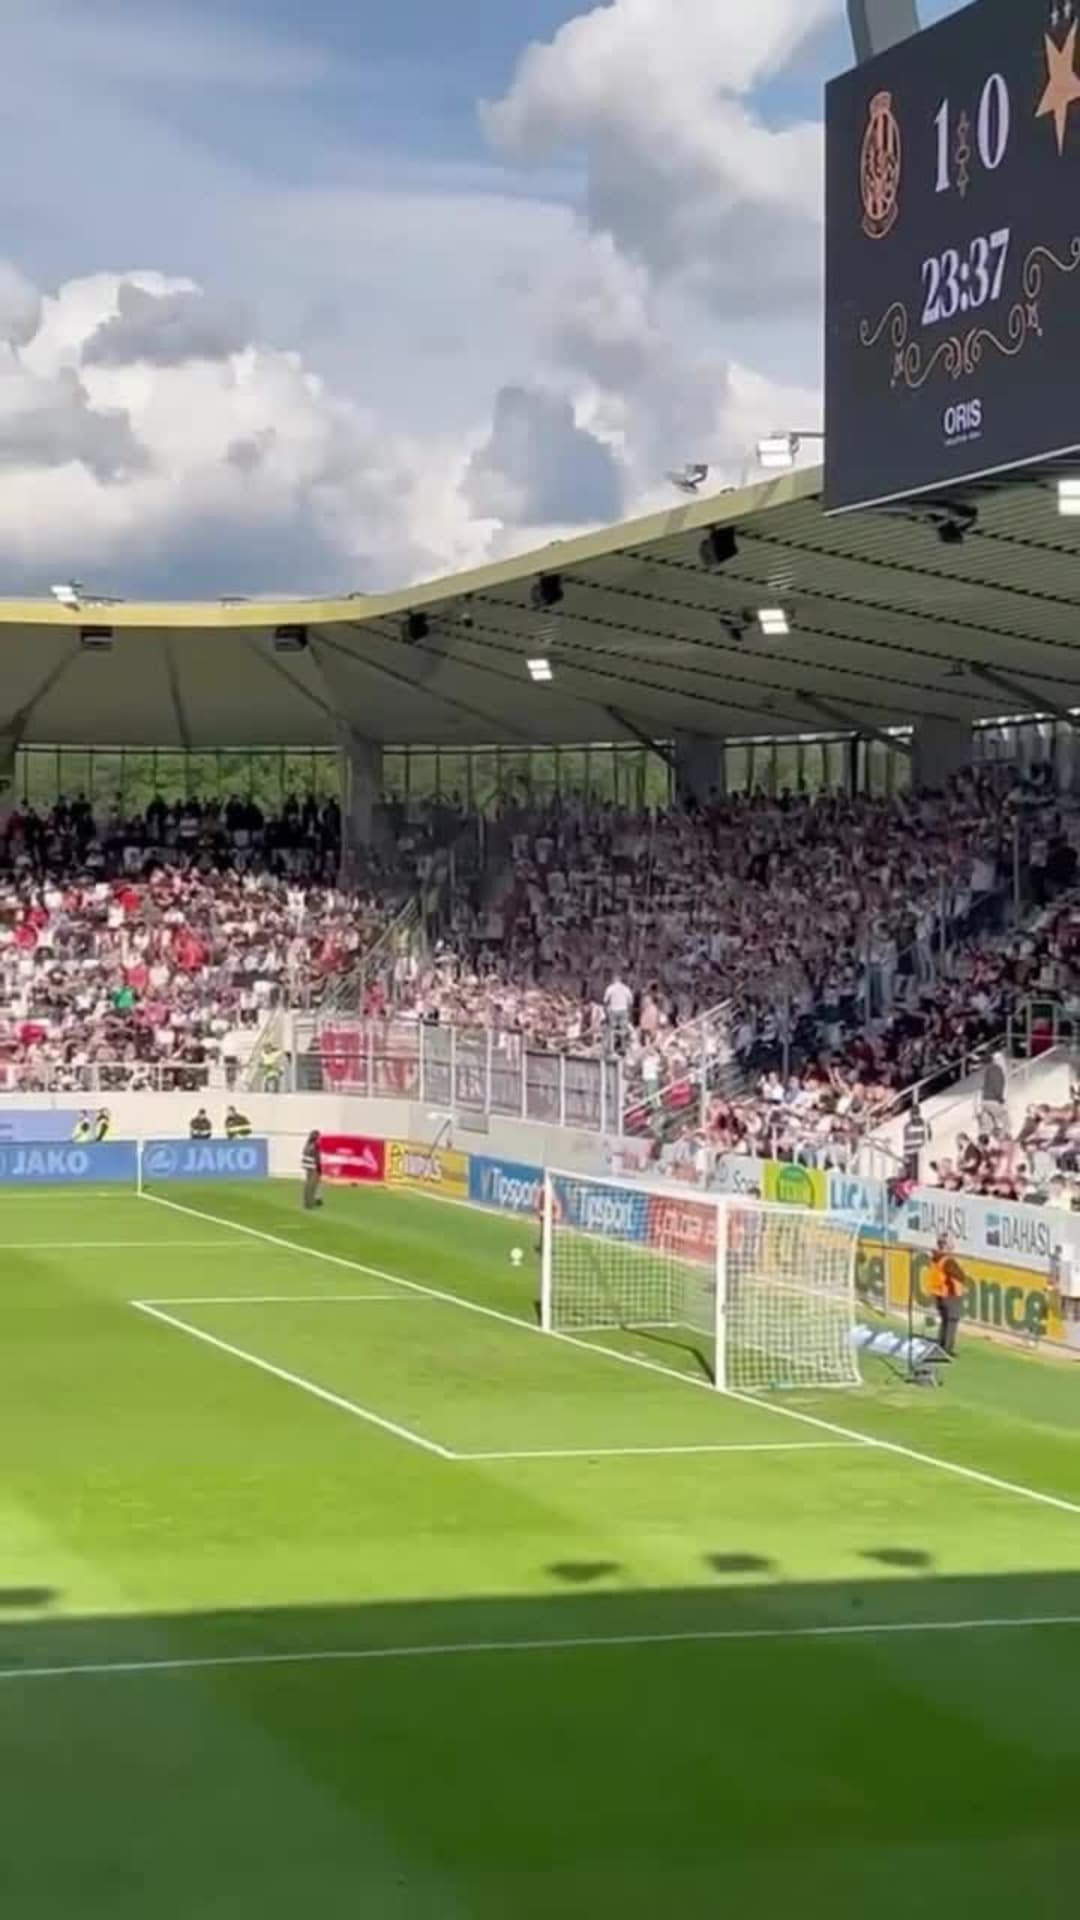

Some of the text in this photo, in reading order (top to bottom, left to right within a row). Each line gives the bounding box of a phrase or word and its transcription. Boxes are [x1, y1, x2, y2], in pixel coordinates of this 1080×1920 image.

[934, 72, 1010, 192] 1 0
[921, 227, 1010, 325] 23:37
[944, 398, 981, 435] ORIS
[12, 1149, 89, 1174] JAKO
[183, 1146, 257, 1171] JAKO
[492, 1166, 541, 1210] Tipspor
[577, 1185, 634, 1233] Tipsport
[913, 1252, 1047, 1336] Cance
